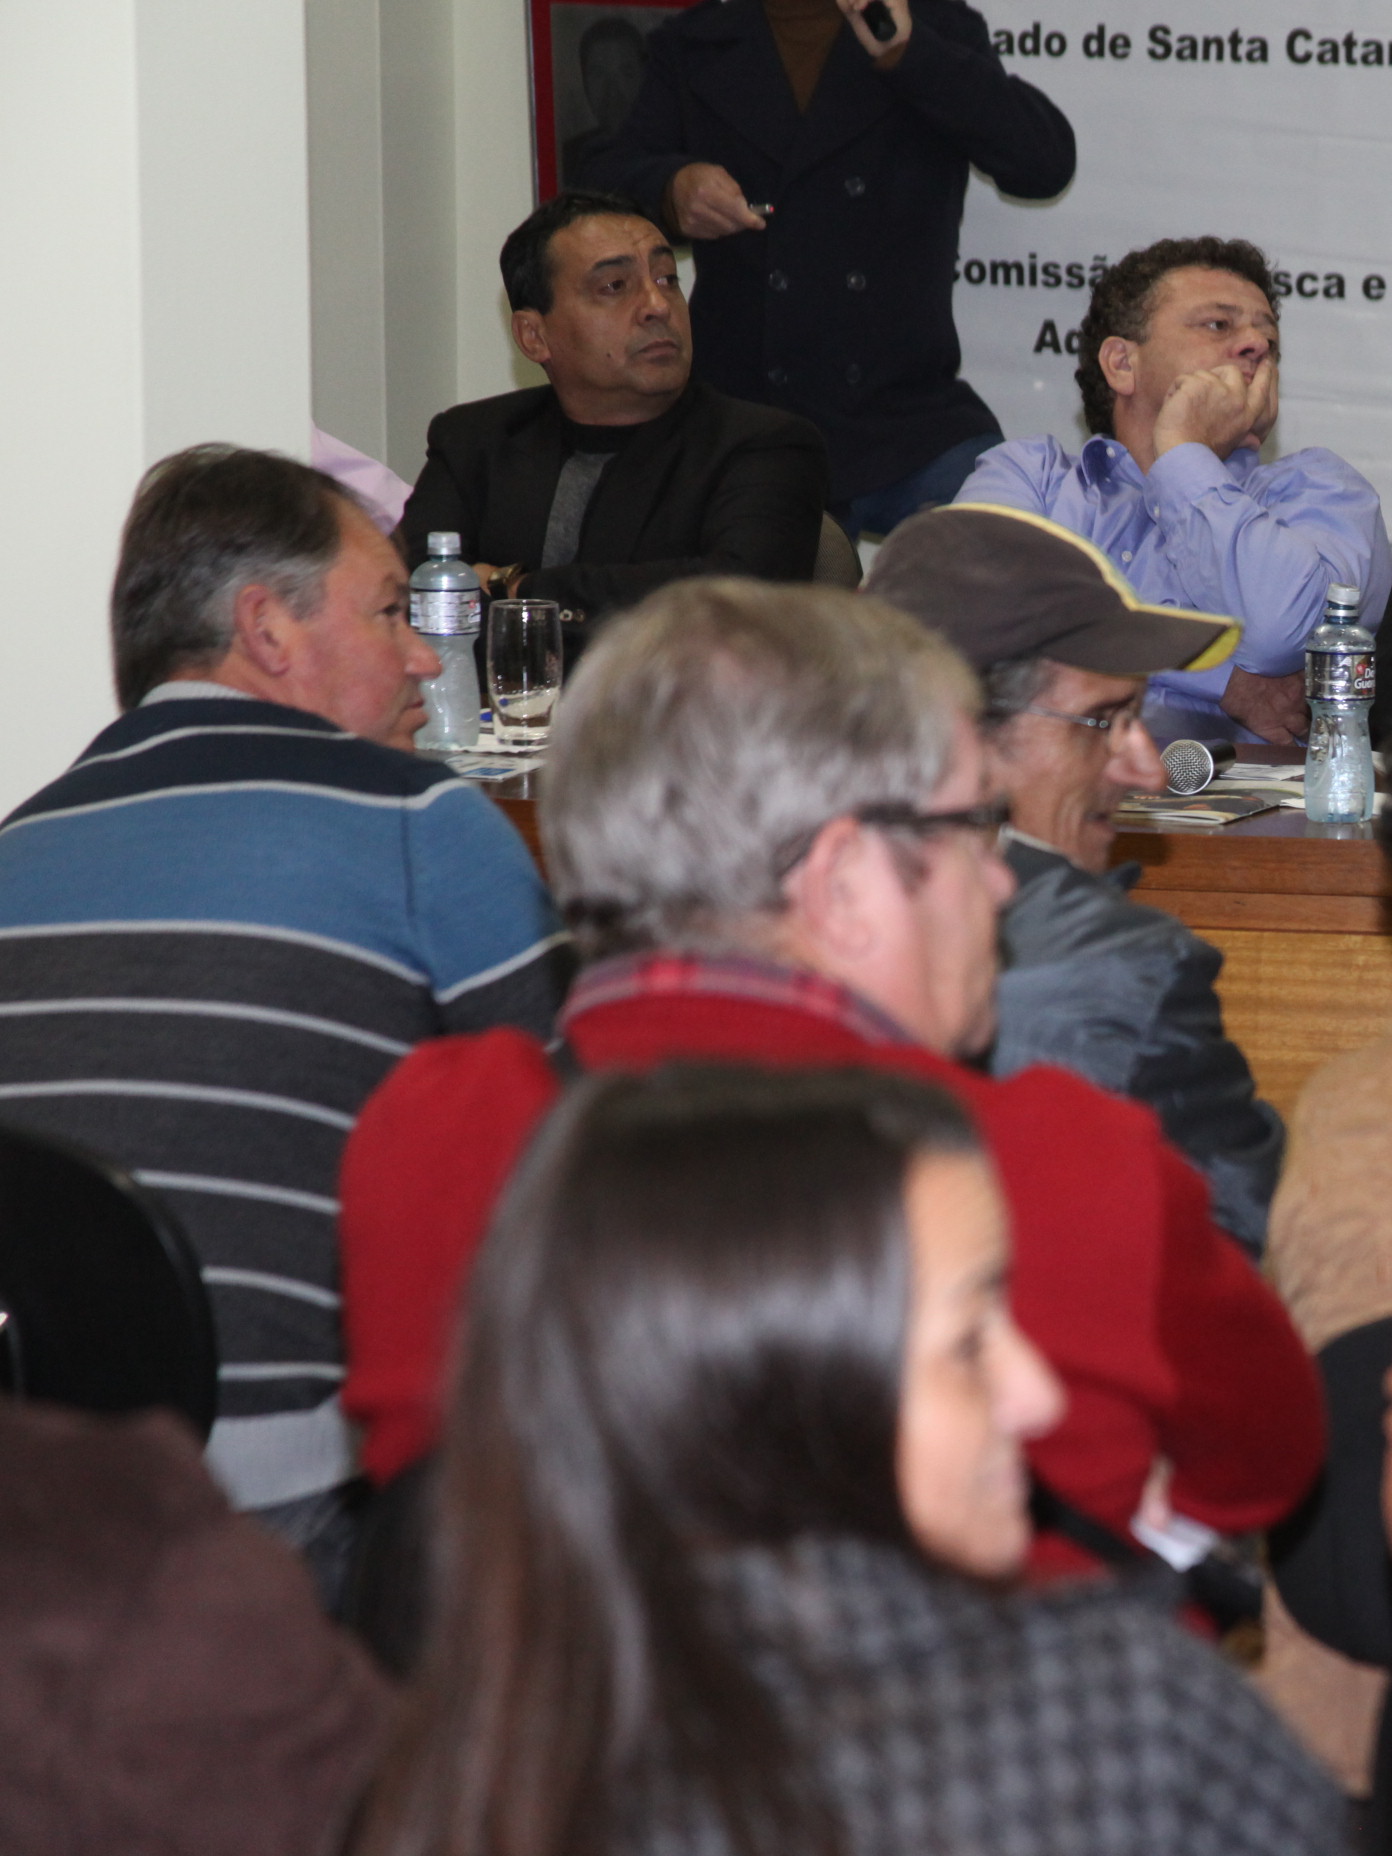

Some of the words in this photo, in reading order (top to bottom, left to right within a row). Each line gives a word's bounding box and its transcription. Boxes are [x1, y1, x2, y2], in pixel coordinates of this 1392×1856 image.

[993, 21, 1067, 57] ado
[1082, 22, 1132, 60] de
[1147, 24, 1269, 63] Santa
[954, 252, 1110, 289] omissã
[1273, 270, 1346, 299] sca
[1362, 273, 1387, 301] e
